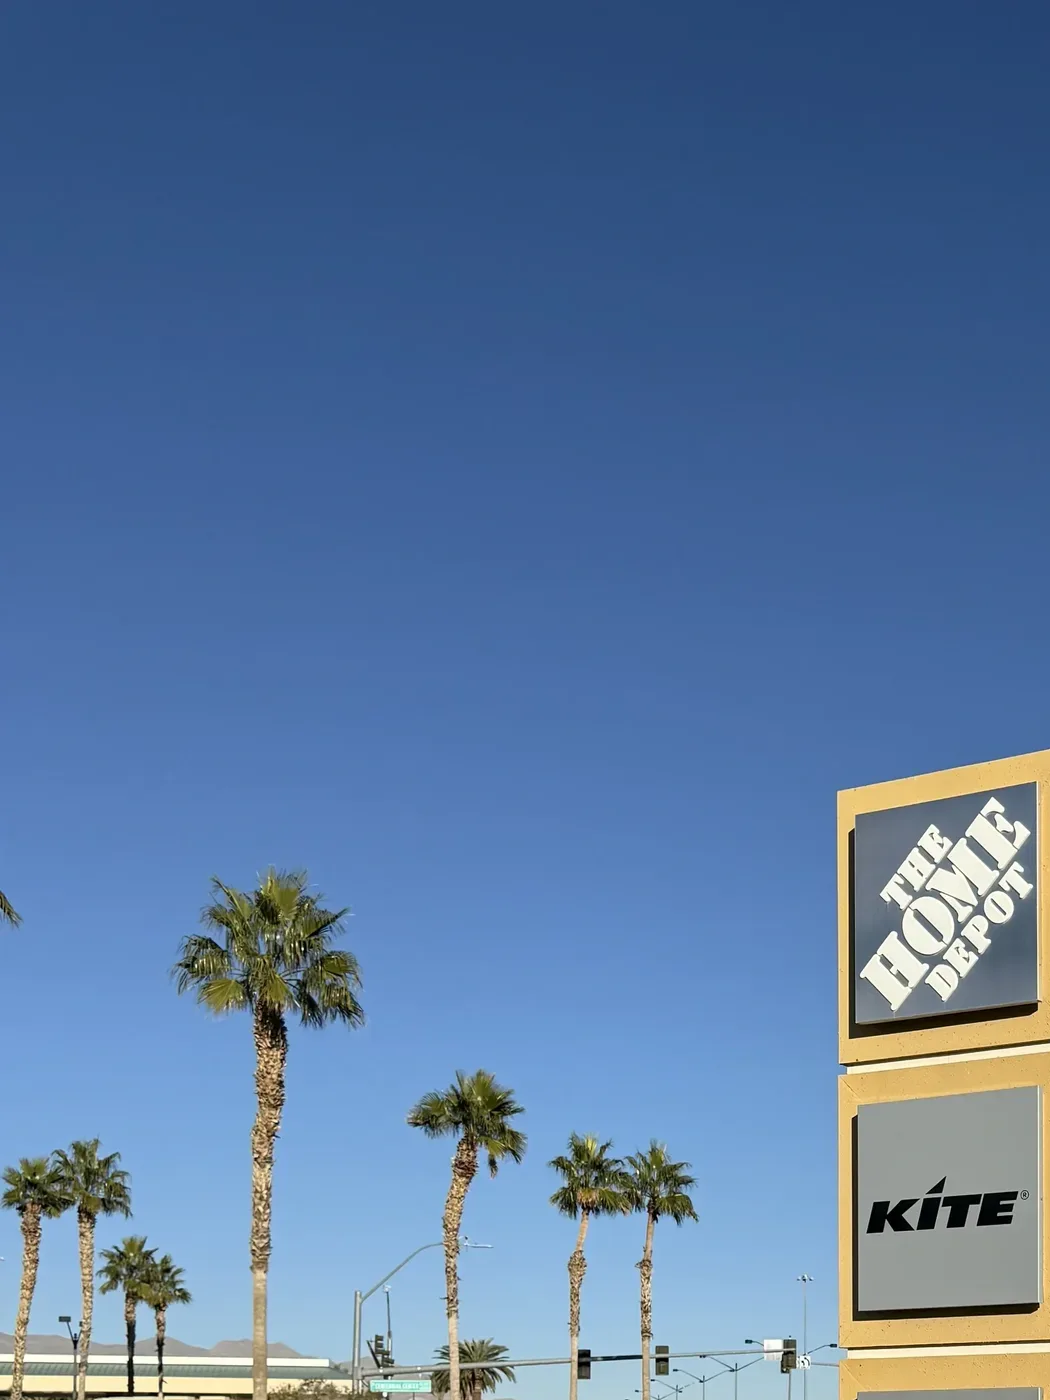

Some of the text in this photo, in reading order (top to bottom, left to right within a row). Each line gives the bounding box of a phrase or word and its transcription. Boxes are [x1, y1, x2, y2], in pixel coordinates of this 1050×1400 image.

[859, 796, 1031, 1012] HOME
[879, 824, 953, 910] THE
[924, 861, 1033, 1002] DEPOT
